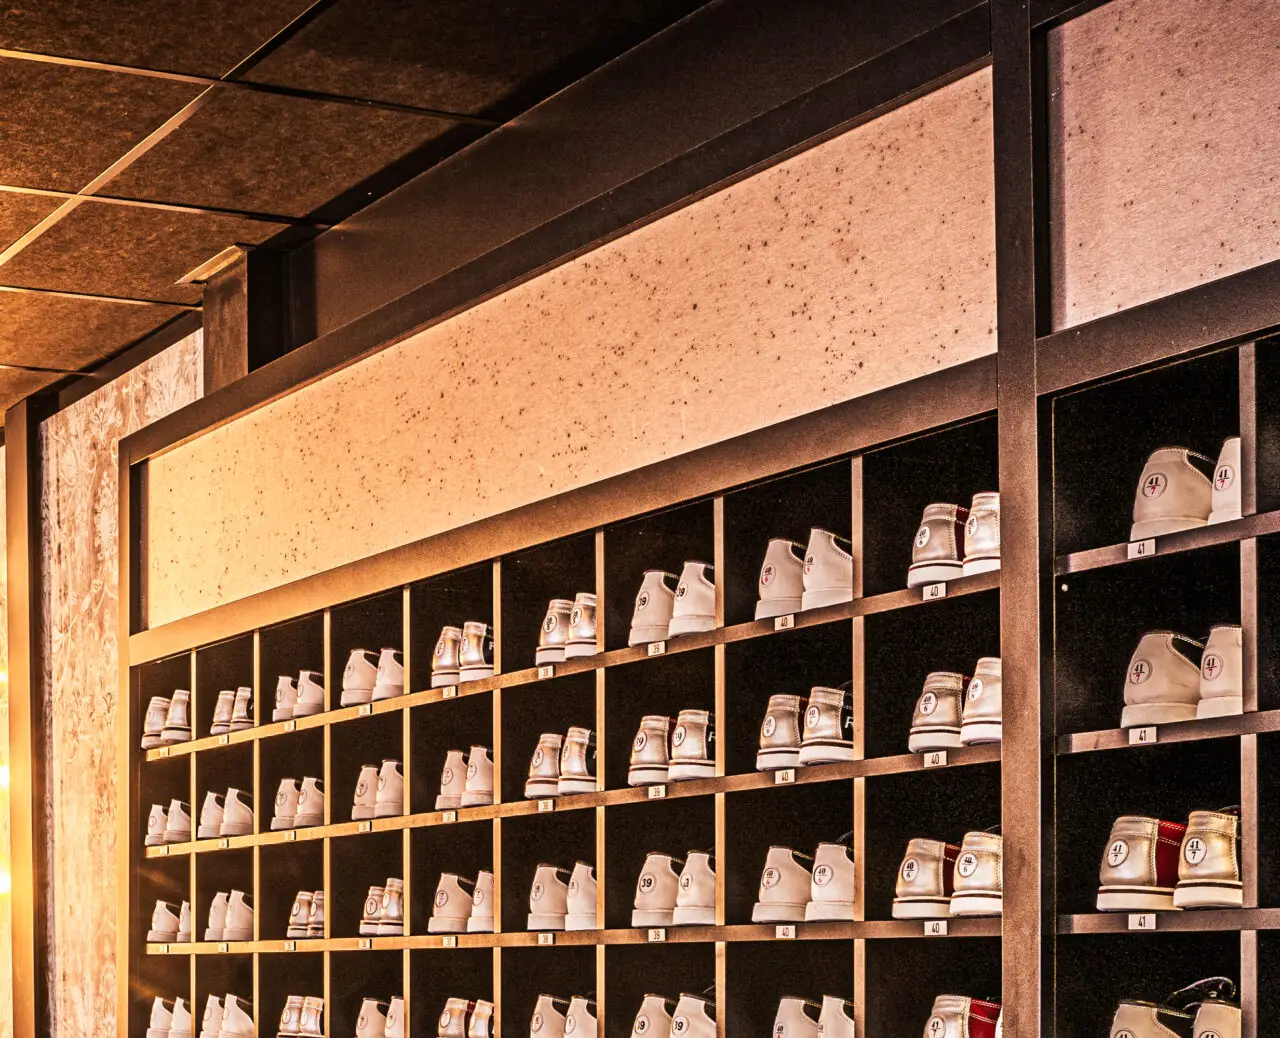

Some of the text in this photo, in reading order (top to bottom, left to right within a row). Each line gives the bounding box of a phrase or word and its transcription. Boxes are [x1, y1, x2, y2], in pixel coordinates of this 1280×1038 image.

[1218, 469, 1228, 478] 41
[1148, 476, 1159, 486] 41
[1137, 543, 1145, 555] 41
[931, 586, 938, 597] 40
[1134, 663, 1144, 673] 41
[1206, 658, 1215, 668] 41
[1139, 730, 1147, 741] 41
[931, 754, 939, 764] 40
[1112, 844, 1123, 853] 41
[1190, 840, 1199, 849] 41
[642, 878, 653, 887] 39
[1138, 916, 1146, 927] 41
[932, 923, 940, 933] 40
